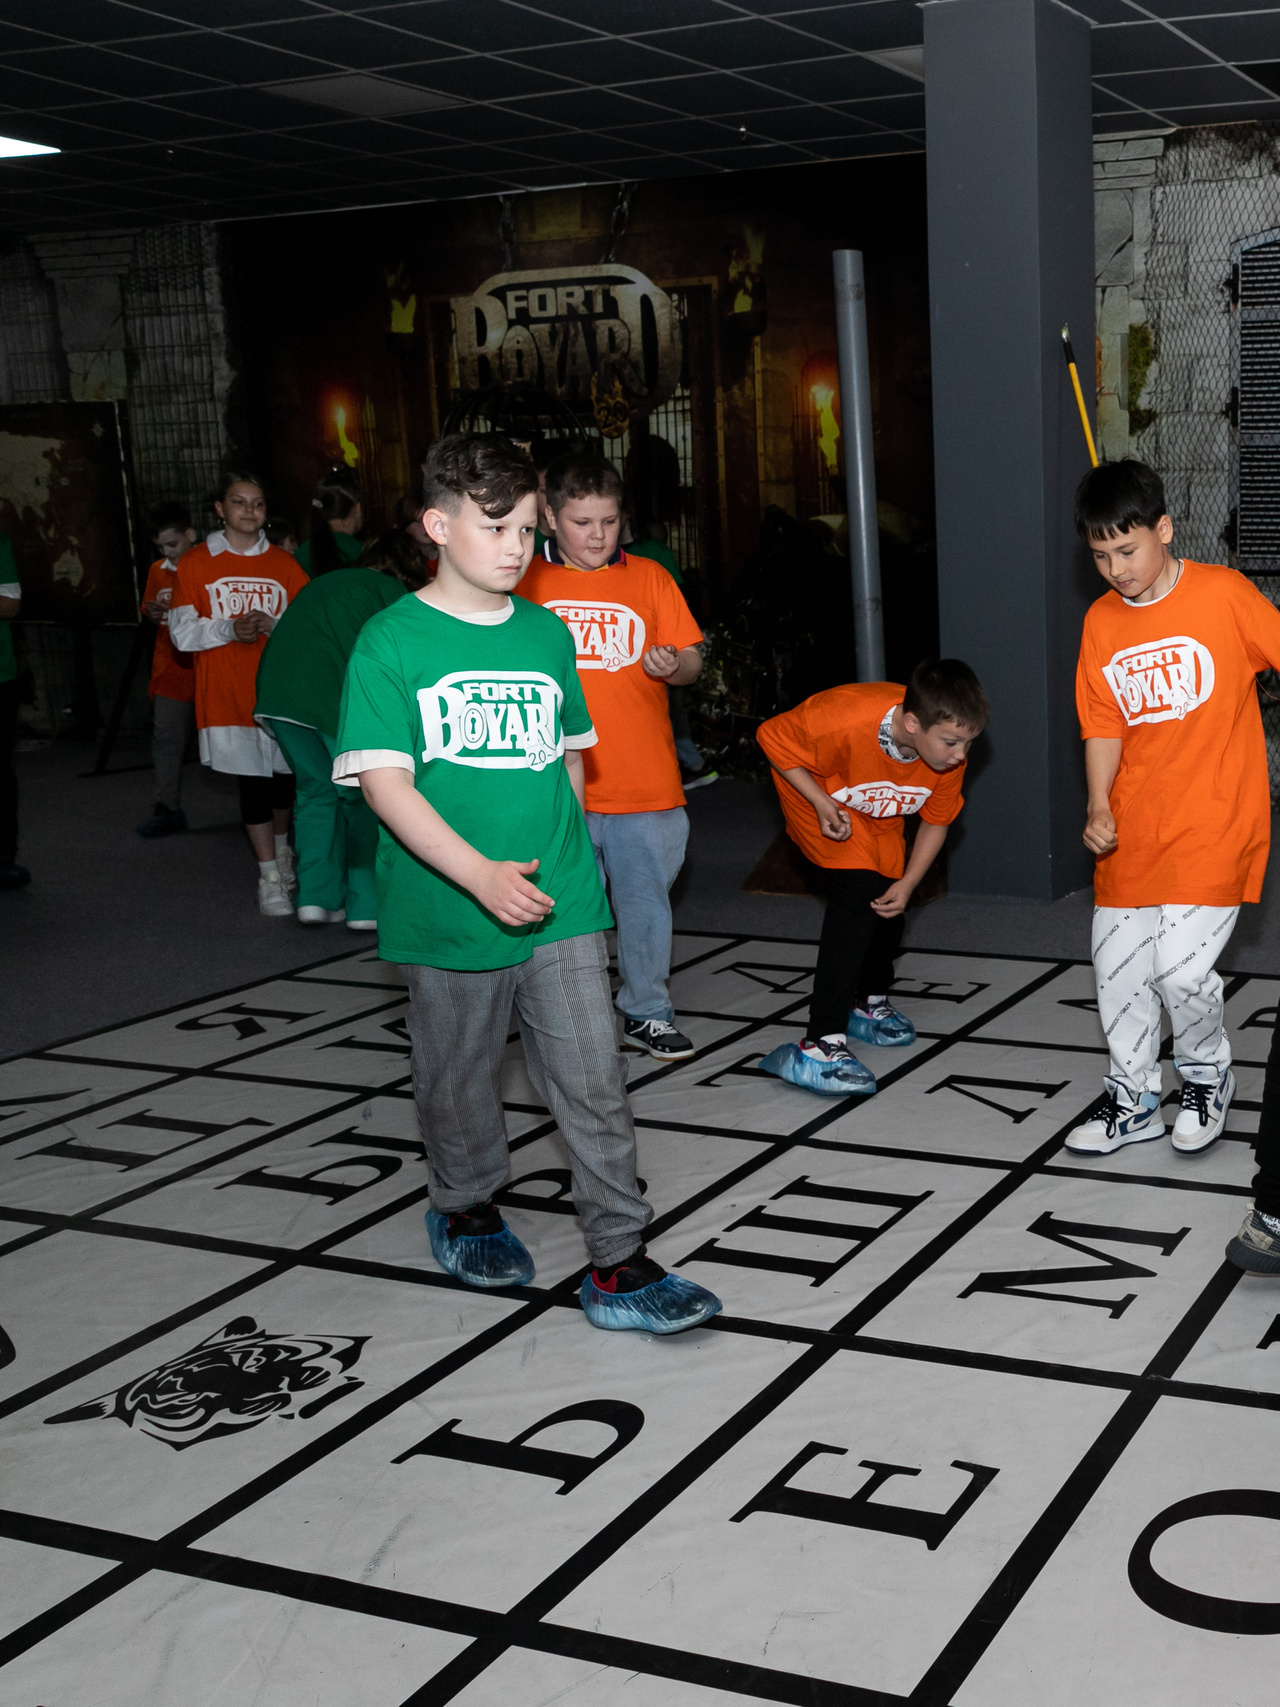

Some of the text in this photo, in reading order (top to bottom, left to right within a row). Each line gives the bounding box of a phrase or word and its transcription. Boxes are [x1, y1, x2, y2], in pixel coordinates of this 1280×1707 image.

[506, 285, 609, 320] FORT
[450, 270, 682, 407] BOYARD
[228, 582, 271, 593] FORT
[555, 608, 617, 622] FORT
[568, 607, 646, 667] YARD
[1122, 647, 1176, 675] FORT
[462, 683, 539, 701] FORT
[1101, 641, 1215, 726] BOYARD
[417, 677, 564, 766] BOYARD
[864, 788, 916, 804] FORT
[175, 1002, 326, 1040] Я
[925, 1074, 1072, 1124] Л
[15, 1108, 275, 1173] Ц
[672, 1175, 934, 1288] Ш
[956, 1210, 1192, 1319] М
[390, 1399, 645, 1496] Ь
[728, 1440, 1000, 1551] Е
